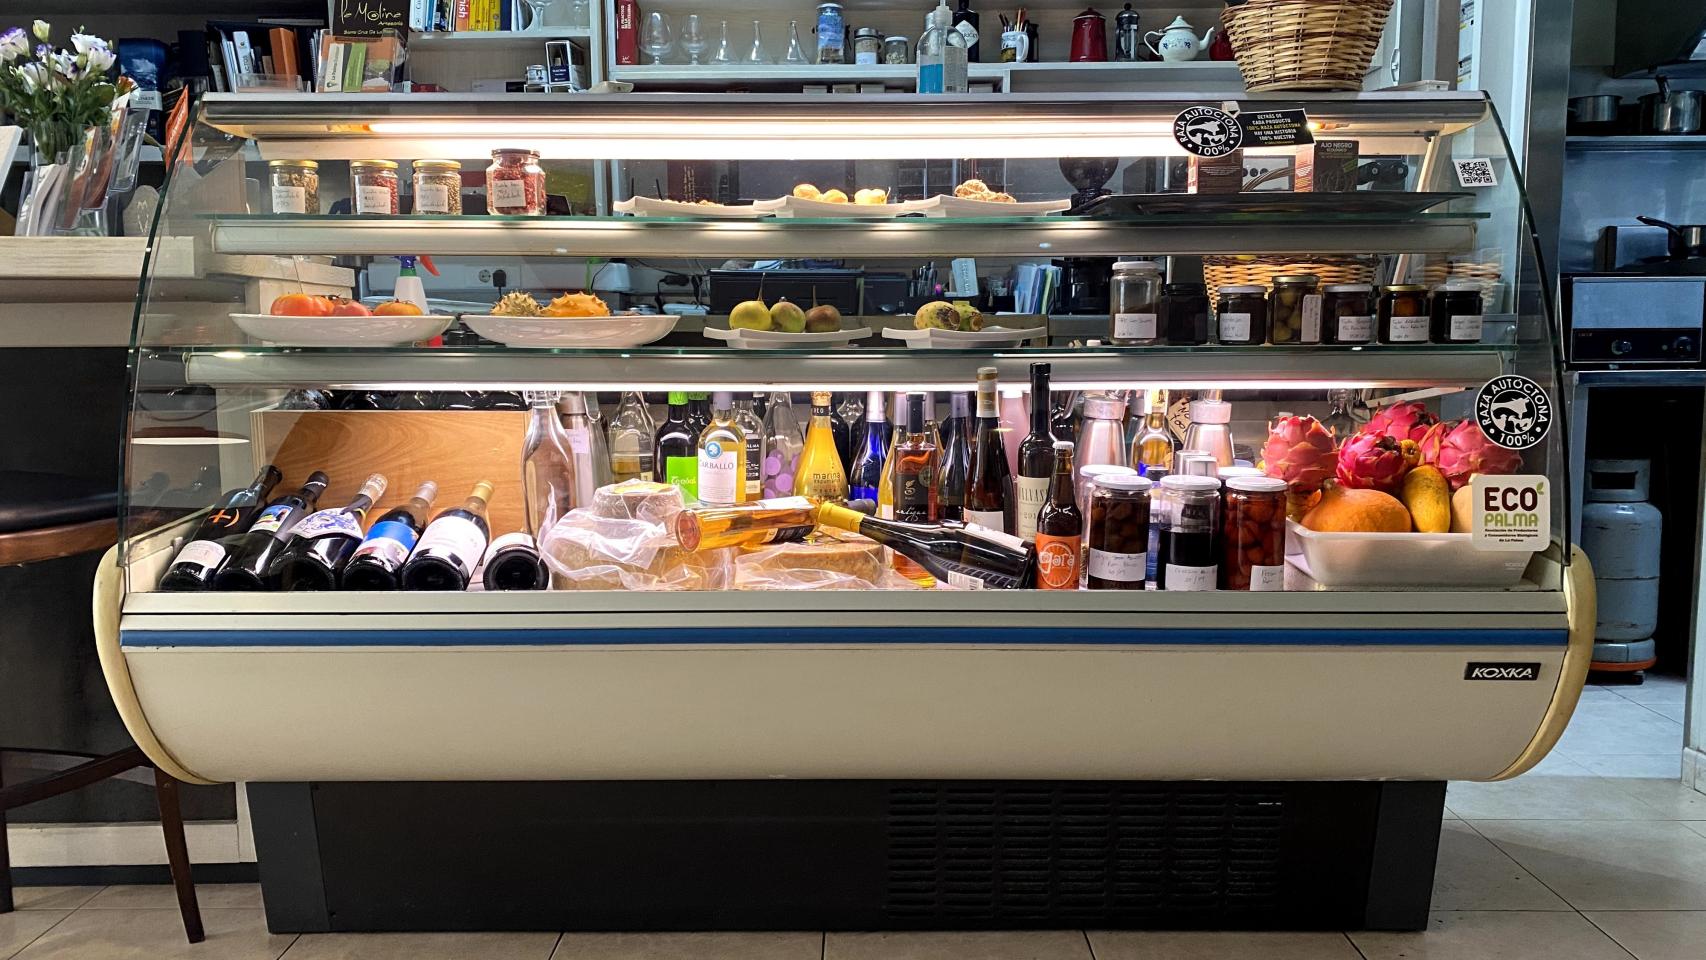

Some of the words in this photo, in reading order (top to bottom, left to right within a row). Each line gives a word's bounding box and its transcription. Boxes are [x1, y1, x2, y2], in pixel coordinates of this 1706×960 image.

[354, 2, 402, 23] Molina
[1176, 121, 1188, 142] RAZA
[1198, 145, 1230, 155] 100%
[1480, 395, 1492, 426] RAZA
[1500, 432, 1535, 446] 100%
[1484, 487, 1538, 511] ECO
[1484, 512, 1539, 527] PALMA
[1471, 667, 1533, 678] KOXKA
